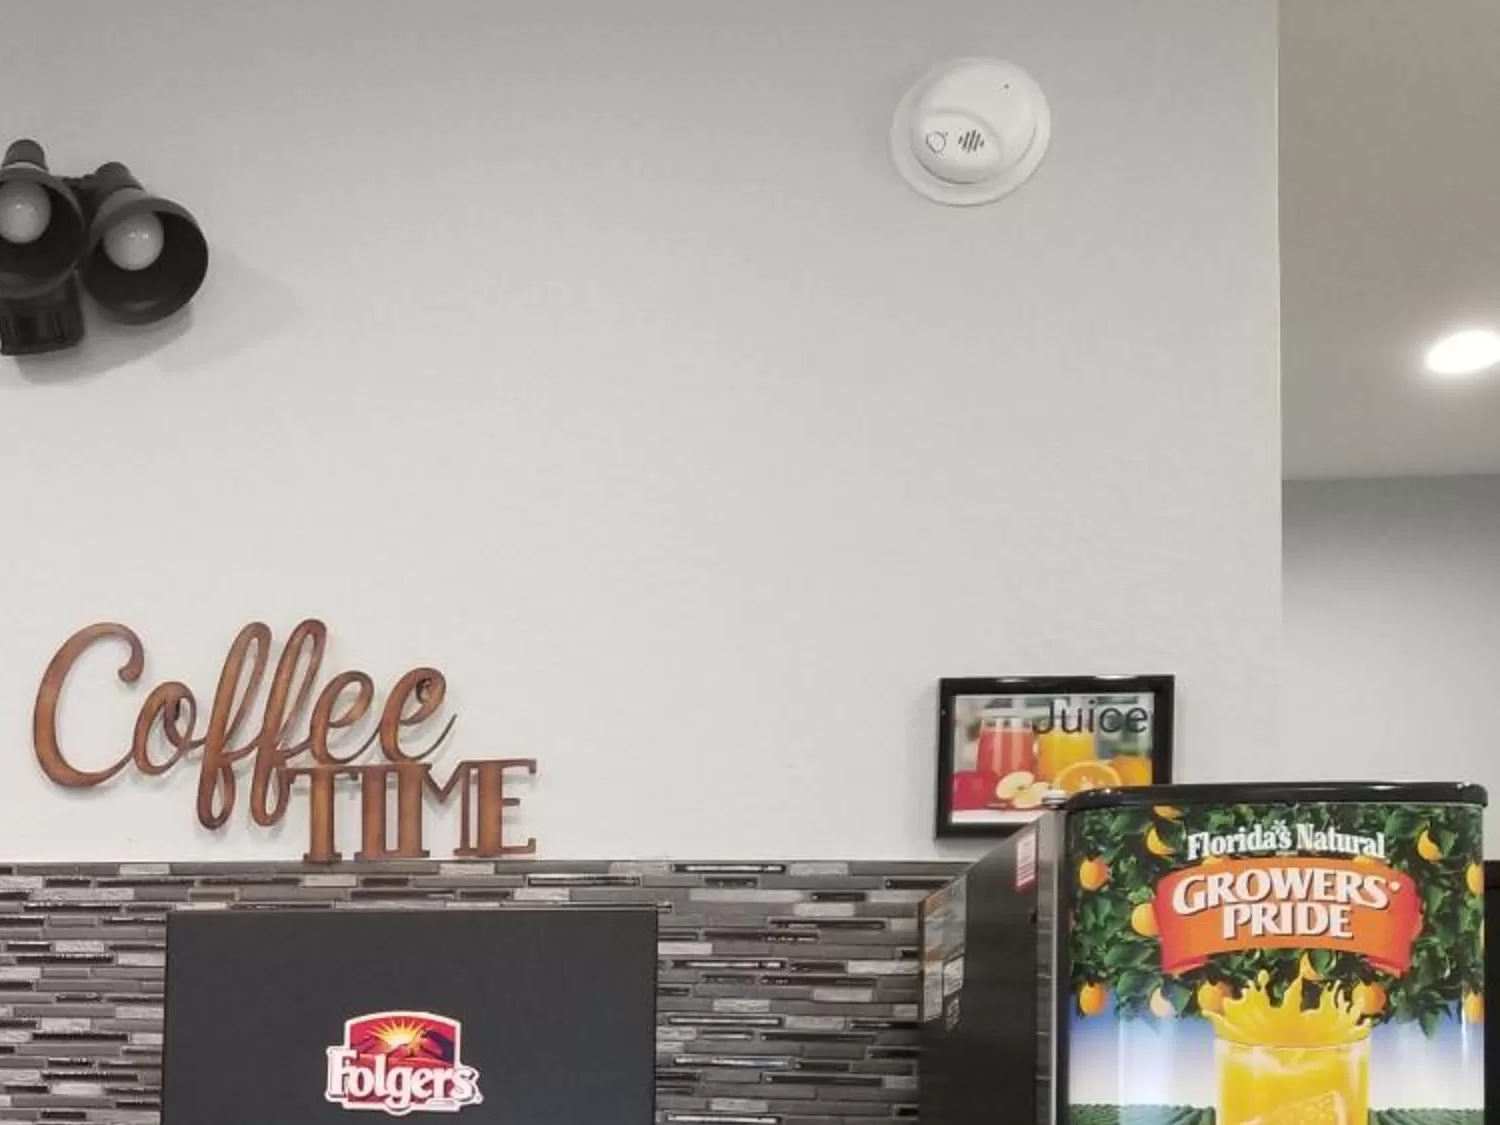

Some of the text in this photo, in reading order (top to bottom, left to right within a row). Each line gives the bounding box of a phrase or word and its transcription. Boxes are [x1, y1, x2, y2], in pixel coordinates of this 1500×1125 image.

[32, 618, 457, 830] Coffee
[1031, 697, 1149, 735] Juice
[279, 758, 537, 864] TIME
[1187, 820, 1387, 861] Florida's Natural
[1223, 902, 1355, 941] PRIDE
[326, 1047, 477, 1109] Folgers
